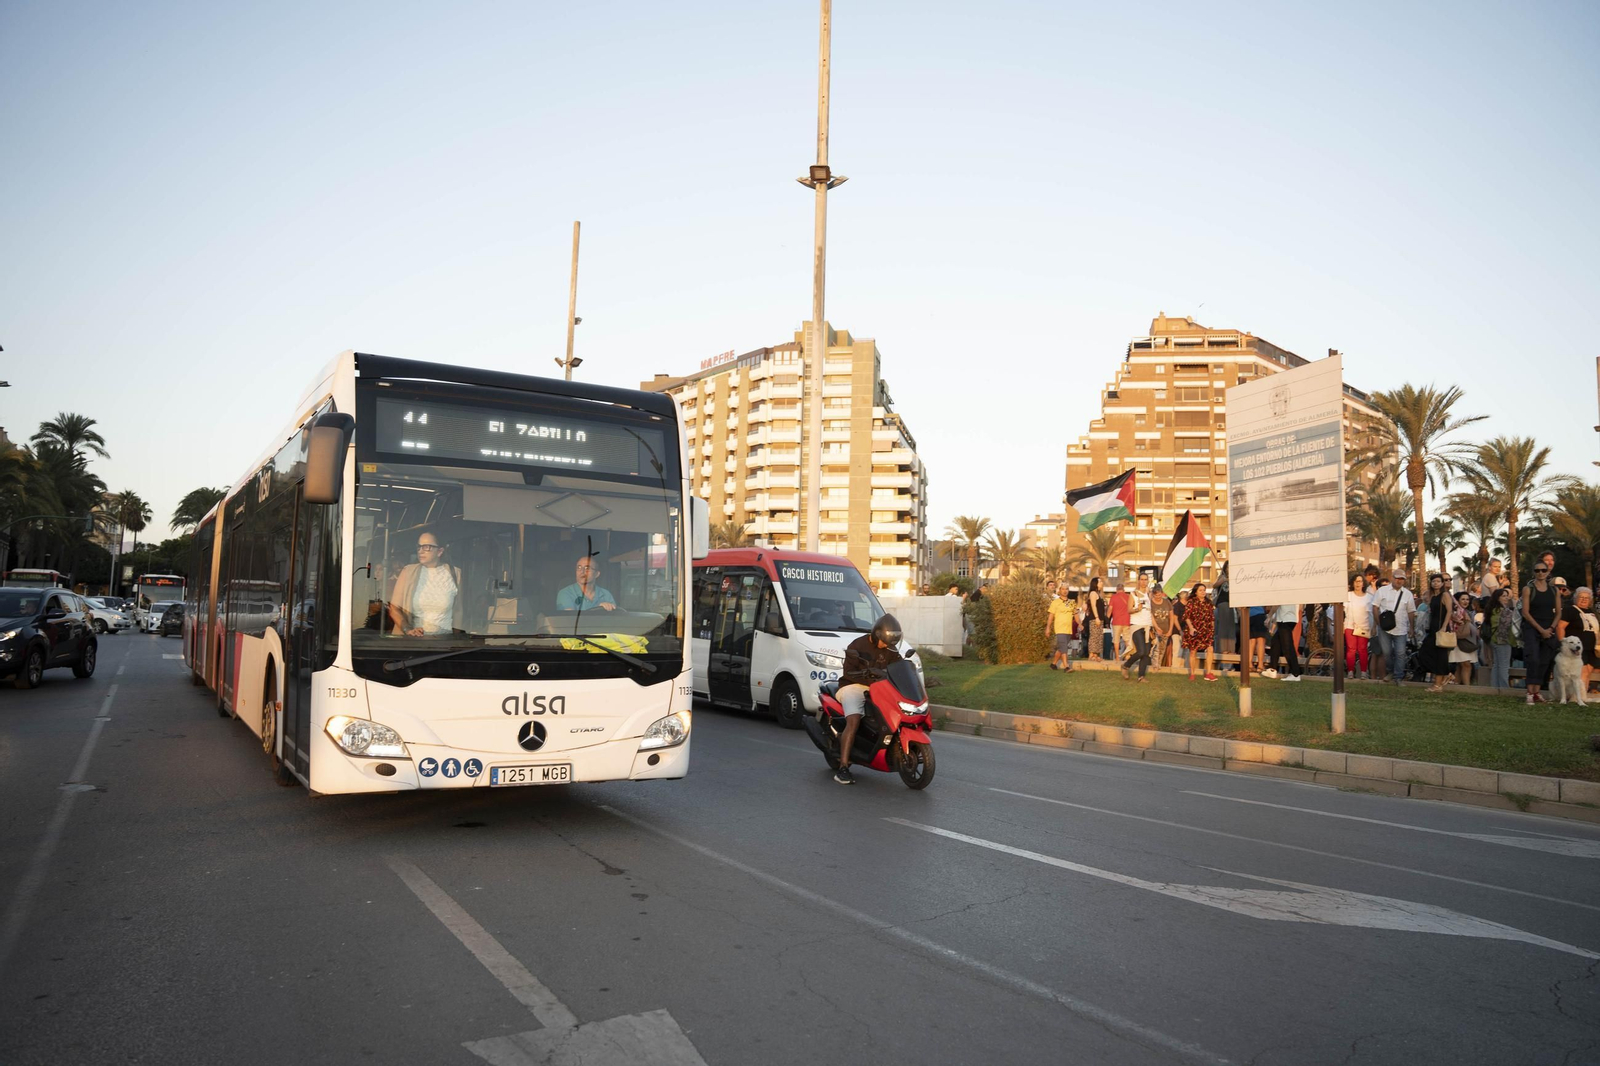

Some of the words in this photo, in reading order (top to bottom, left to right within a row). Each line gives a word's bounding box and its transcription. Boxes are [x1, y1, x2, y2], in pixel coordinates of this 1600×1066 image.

[700, 350, 735, 370] MAPFRE
[1234, 452, 1256, 468] MEJORA
[1256, 448, 1282, 464] ENTORNO
[1283, 446, 1292, 457] DE
[1292, 444, 1300, 455] LA
[1302, 438, 1325, 453] FUENTE
[1326, 436, 1335, 448] DE
[1266, 437, 1286, 449] OBRAS
[1243, 468, 1254, 480] LOS
[1254, 465, 1266, 477] 102
[1266, 460, 1292, 474] PUEBLOS
[1292, 452, 1324, 471] (ALMERÍA)
[782, 567, 805, 580] CASCO
[807, 569, 844, 583] HISTORICO
[328, 687, 357, 698] 11330
[501, 691, 566, 716] alsa
[502, 768, 534, 782] 1251
[542, 766, 568, 780] MGB
